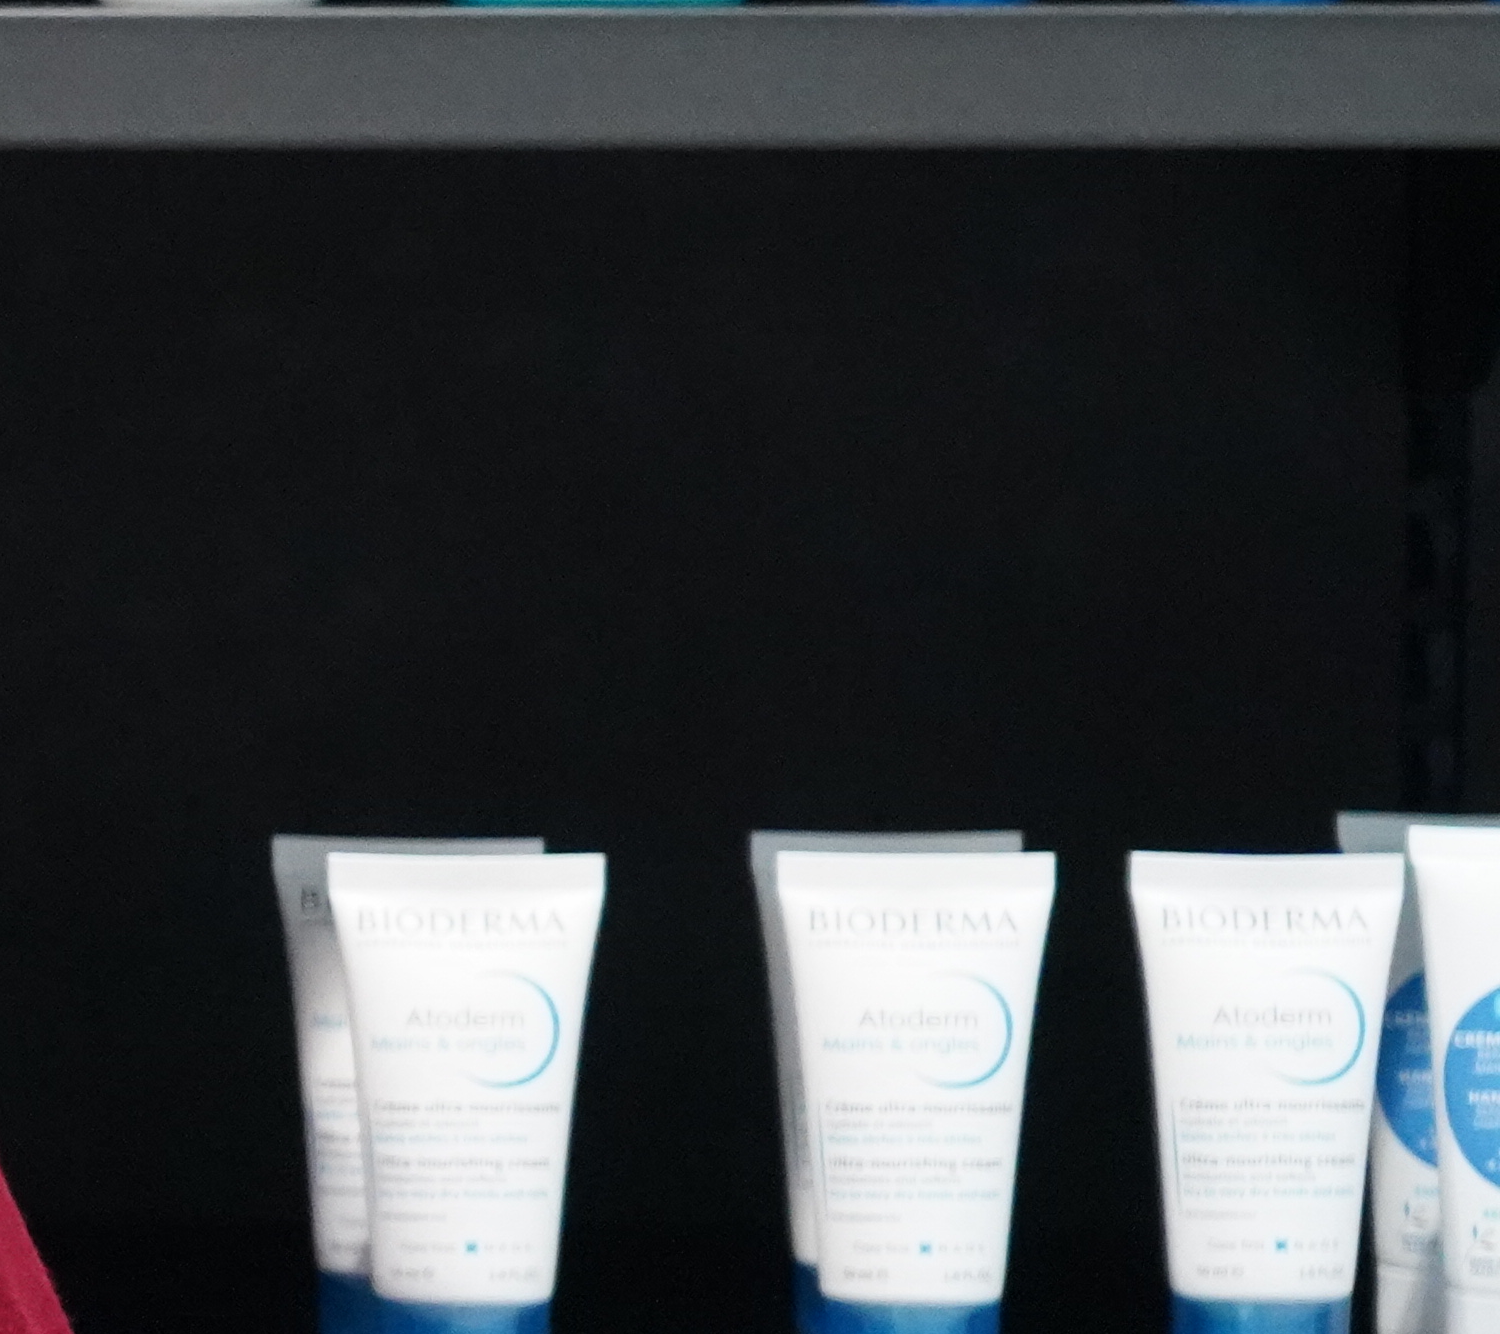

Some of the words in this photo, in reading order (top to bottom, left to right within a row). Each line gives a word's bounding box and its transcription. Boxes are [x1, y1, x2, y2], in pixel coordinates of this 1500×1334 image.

[357, 906, 565, 935] BIODERMA
[809, 906, 1019, 935] BIODERMA
[1161, 905, 1370, 934] BIODERMA
[405, 1007, 525, 1028] Atoderm
[858, 1008, 978, 1029] Atoderm
[1212, 1005, 1333, 1026] Atoderm
